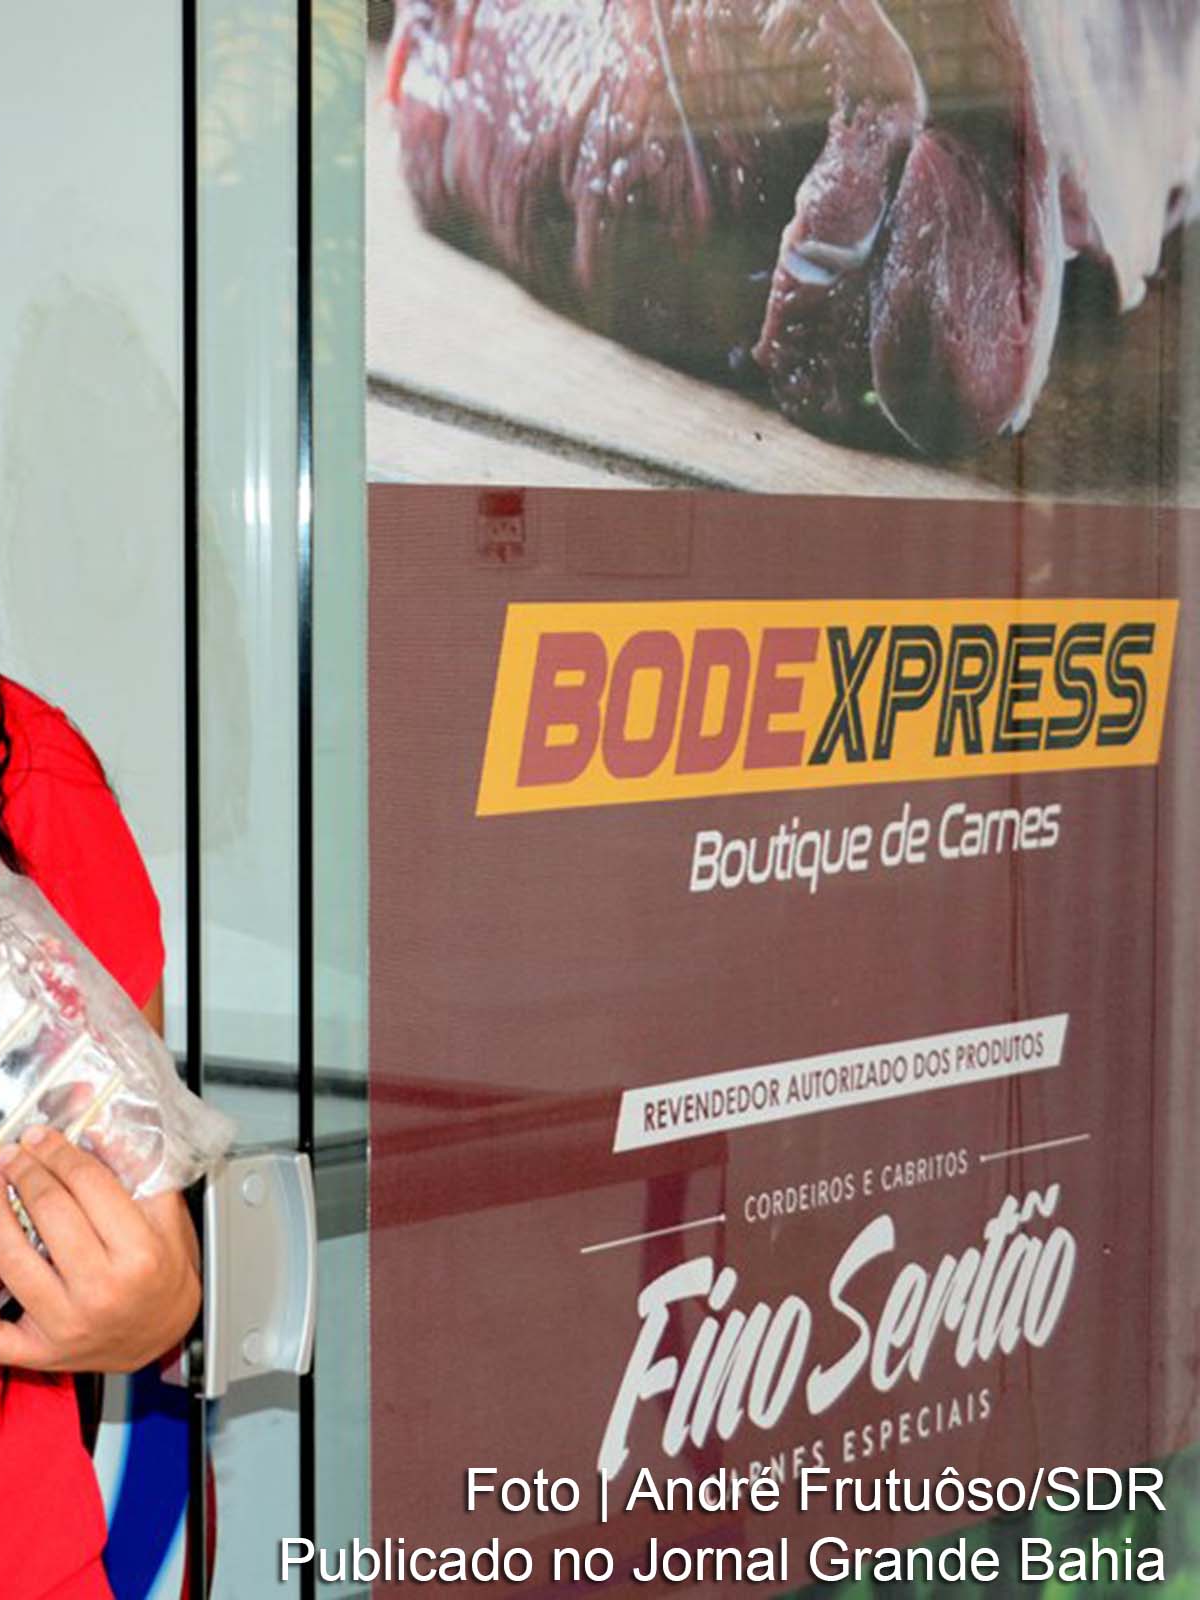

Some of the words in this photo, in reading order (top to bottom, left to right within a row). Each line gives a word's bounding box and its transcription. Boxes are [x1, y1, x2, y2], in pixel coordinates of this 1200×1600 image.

[516, 622, 1155, 787] BODEXPRESS
[690, 817, 872, 893] Boutique
[880, 802, 931, 867] de
[938, 803, 1062, 859] Carnes
[643, 1079, 781, 1132] REVENDEDOR
[786, 1056, 908, 1104] AUTORIZADO
[913, 1048, 951, 1080] DOS
[955, 1031, 1045, 1072] PRODUTOS
[744, 1172, 855, 1222] CORDEIROS
[863, 1169, 873, 1195] E
[880, 1149, 968, 1190] CABRITOS
[597, 1256, 812, 1480] Fino
[806, 1184, 1076, 1416] Sertão
[843, 1388, 990, 1463] ESPECIAIS
